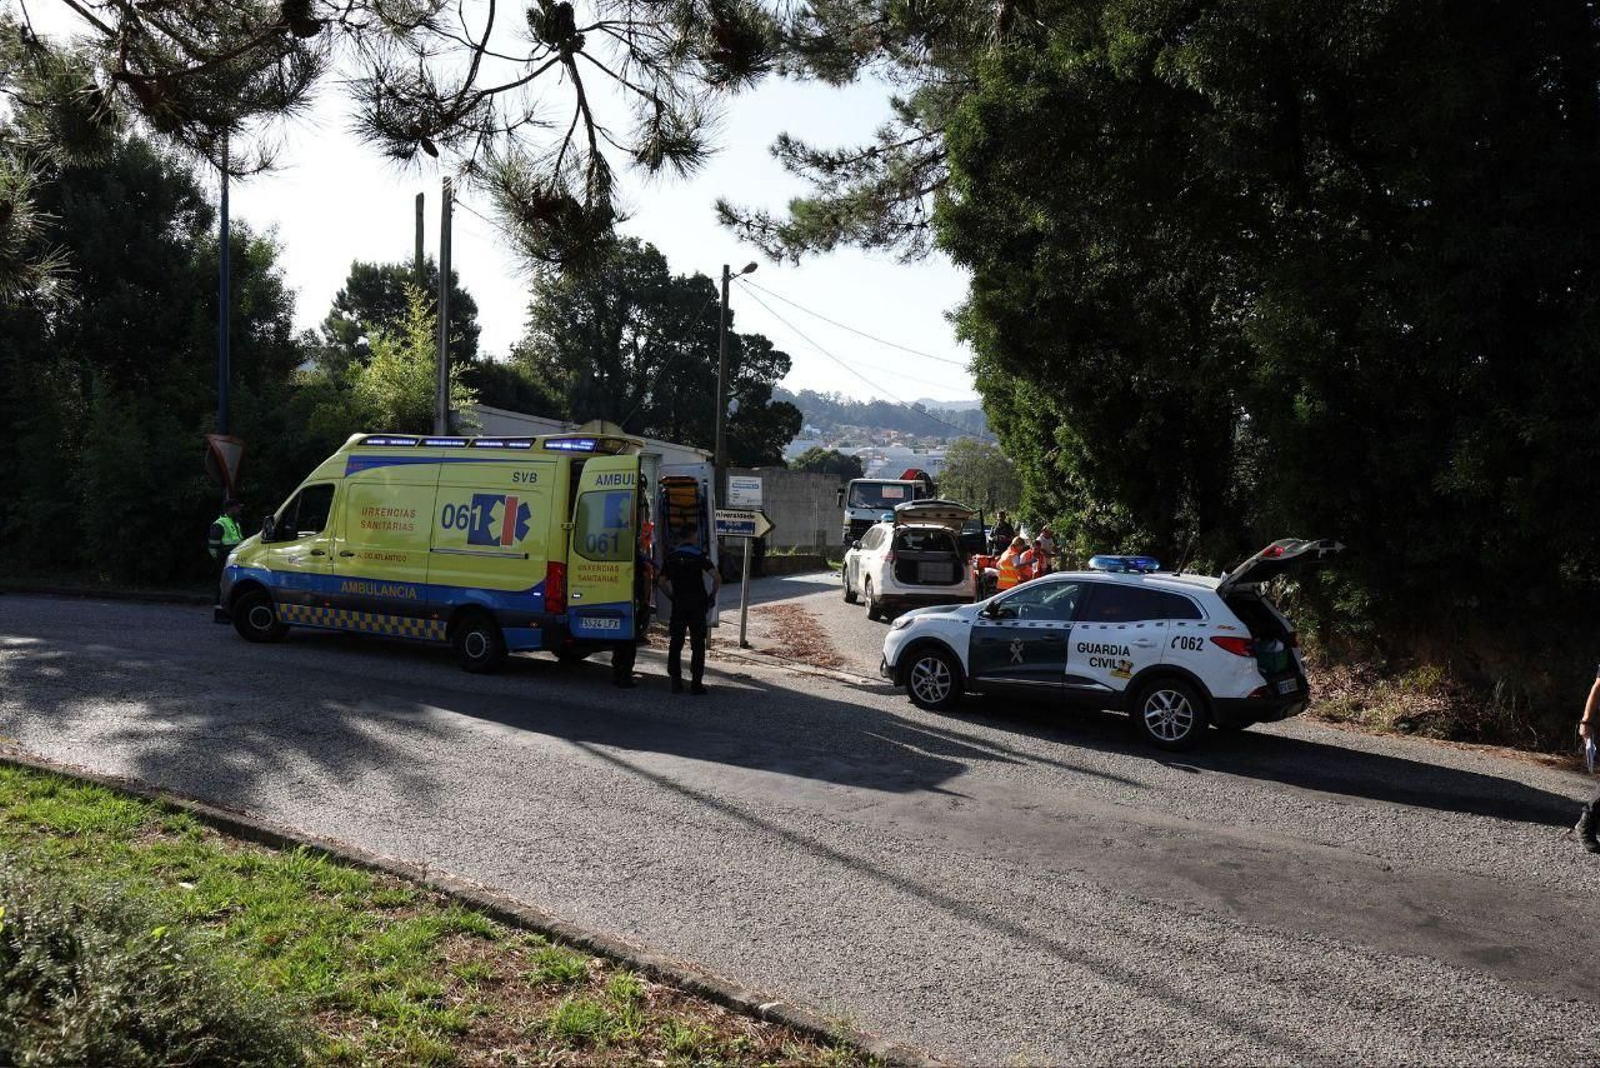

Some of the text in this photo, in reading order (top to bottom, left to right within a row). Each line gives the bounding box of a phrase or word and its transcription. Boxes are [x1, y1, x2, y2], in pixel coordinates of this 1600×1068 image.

[512, 471, 538, 483] SVB
[595, 473, 637, 486] AMBUL
[361, 507, 416, 518] URXENCIAS
[441, 503, 482, 531] 061
[715, 512, 756, 520] niversidade
[360, 520, 415, 532] SANITARIAS
[585, 532, 620, 554] 061
[340, 581, 417, 600] AMBULANCIA
[1077, 642, 1131, 657] GUARDIA
[1180, 636, 1204, 651] 062
[1089, 657, 1118, 669] CIVIL
